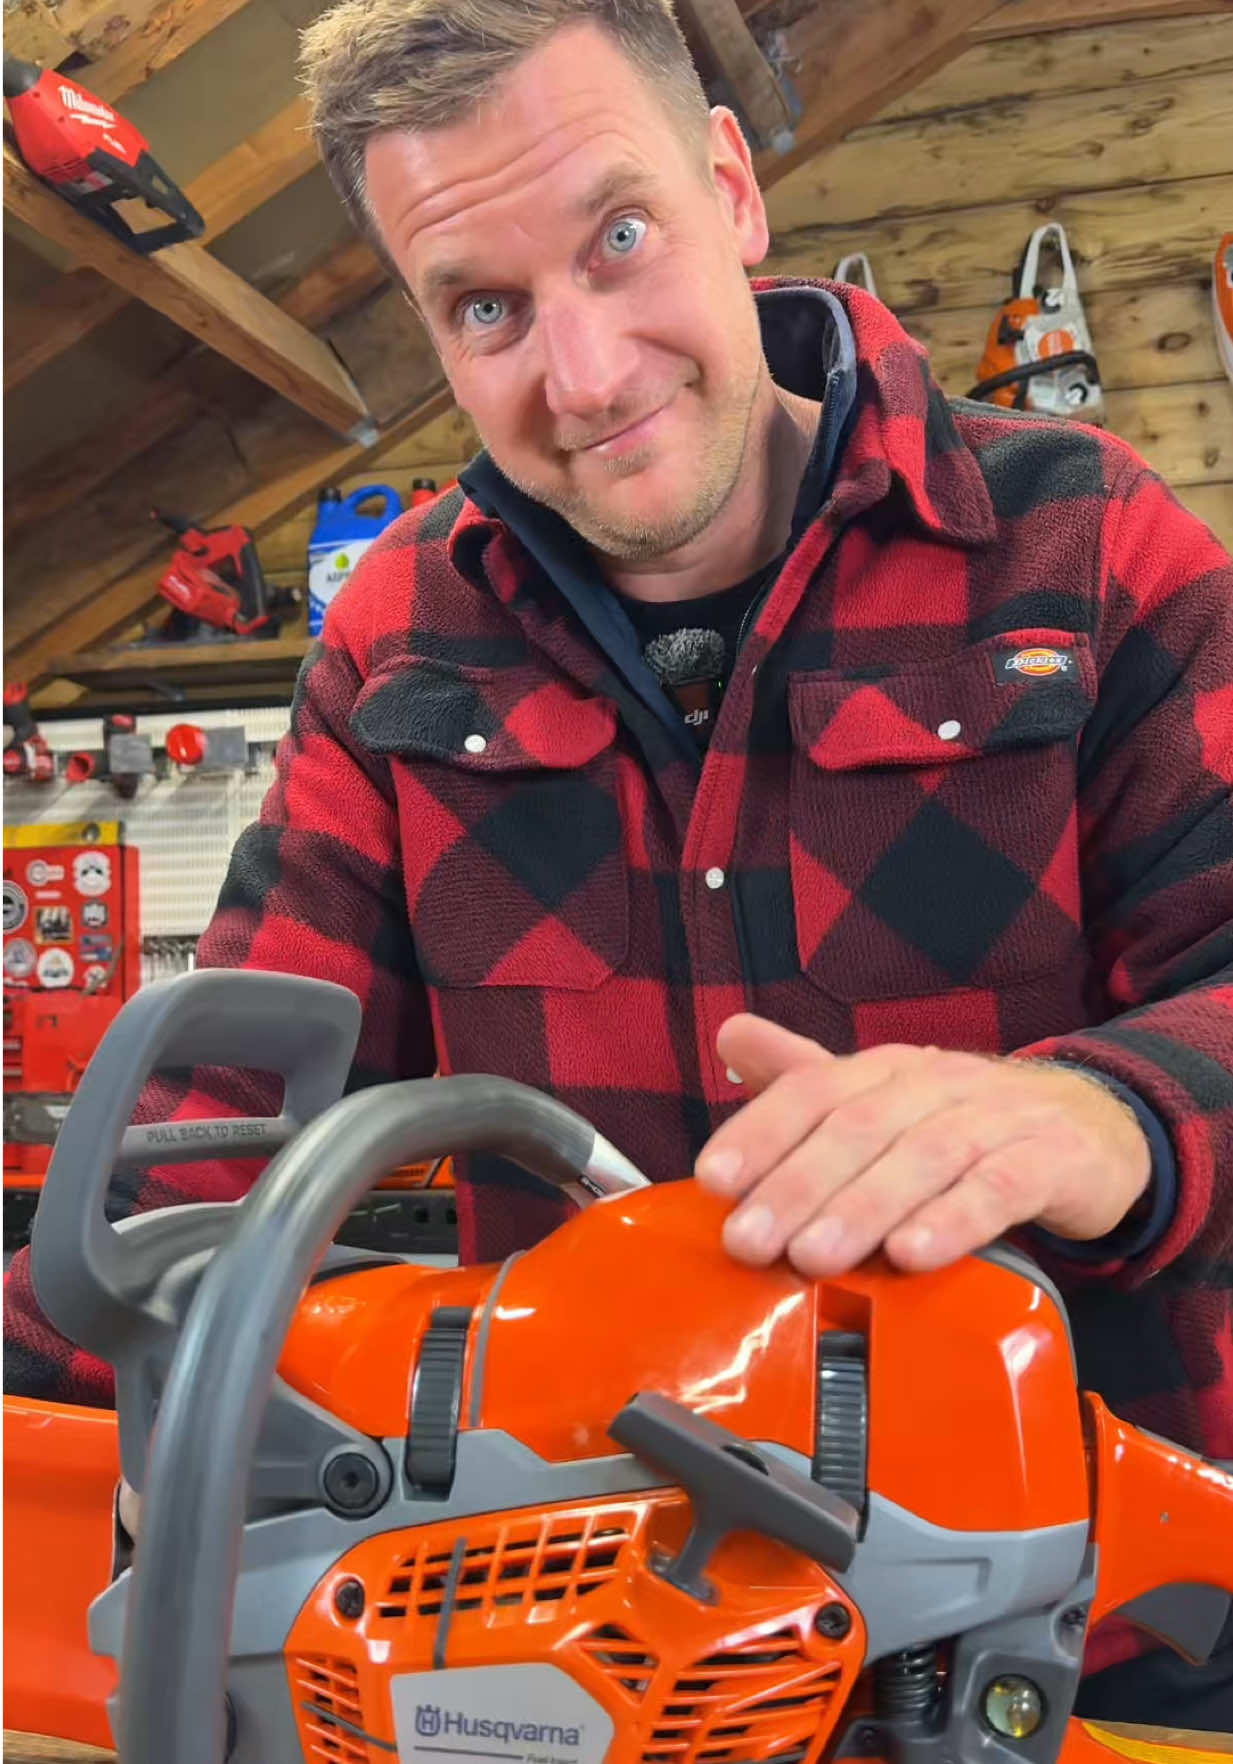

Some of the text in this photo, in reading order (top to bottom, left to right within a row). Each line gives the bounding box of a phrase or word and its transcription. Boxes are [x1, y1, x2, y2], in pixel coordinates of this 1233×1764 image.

[146, 1123, 266, 1142] PULL BACK TO RESET
[443, 1711, 580, 1746] Husqvarna
